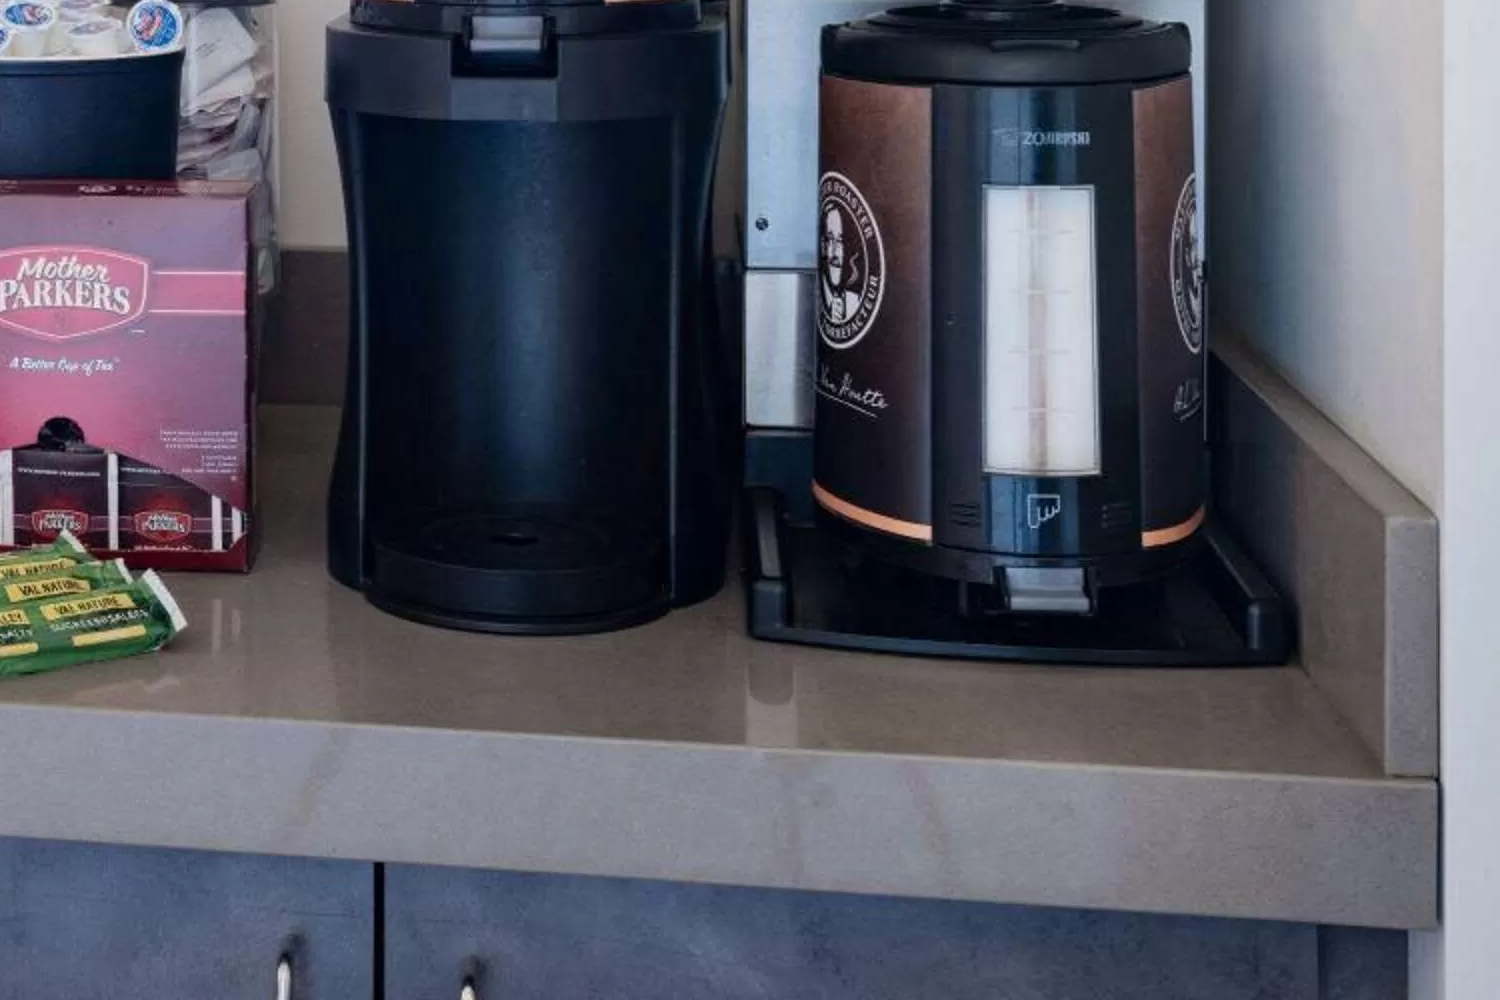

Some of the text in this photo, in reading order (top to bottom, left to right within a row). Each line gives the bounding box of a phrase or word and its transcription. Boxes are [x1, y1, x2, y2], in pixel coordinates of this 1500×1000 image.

[16, 255, 111, 282] Mother
[17, 580, 86, 596] VAL NATURE
[52, 596, 122, 616] VAL NATURE
